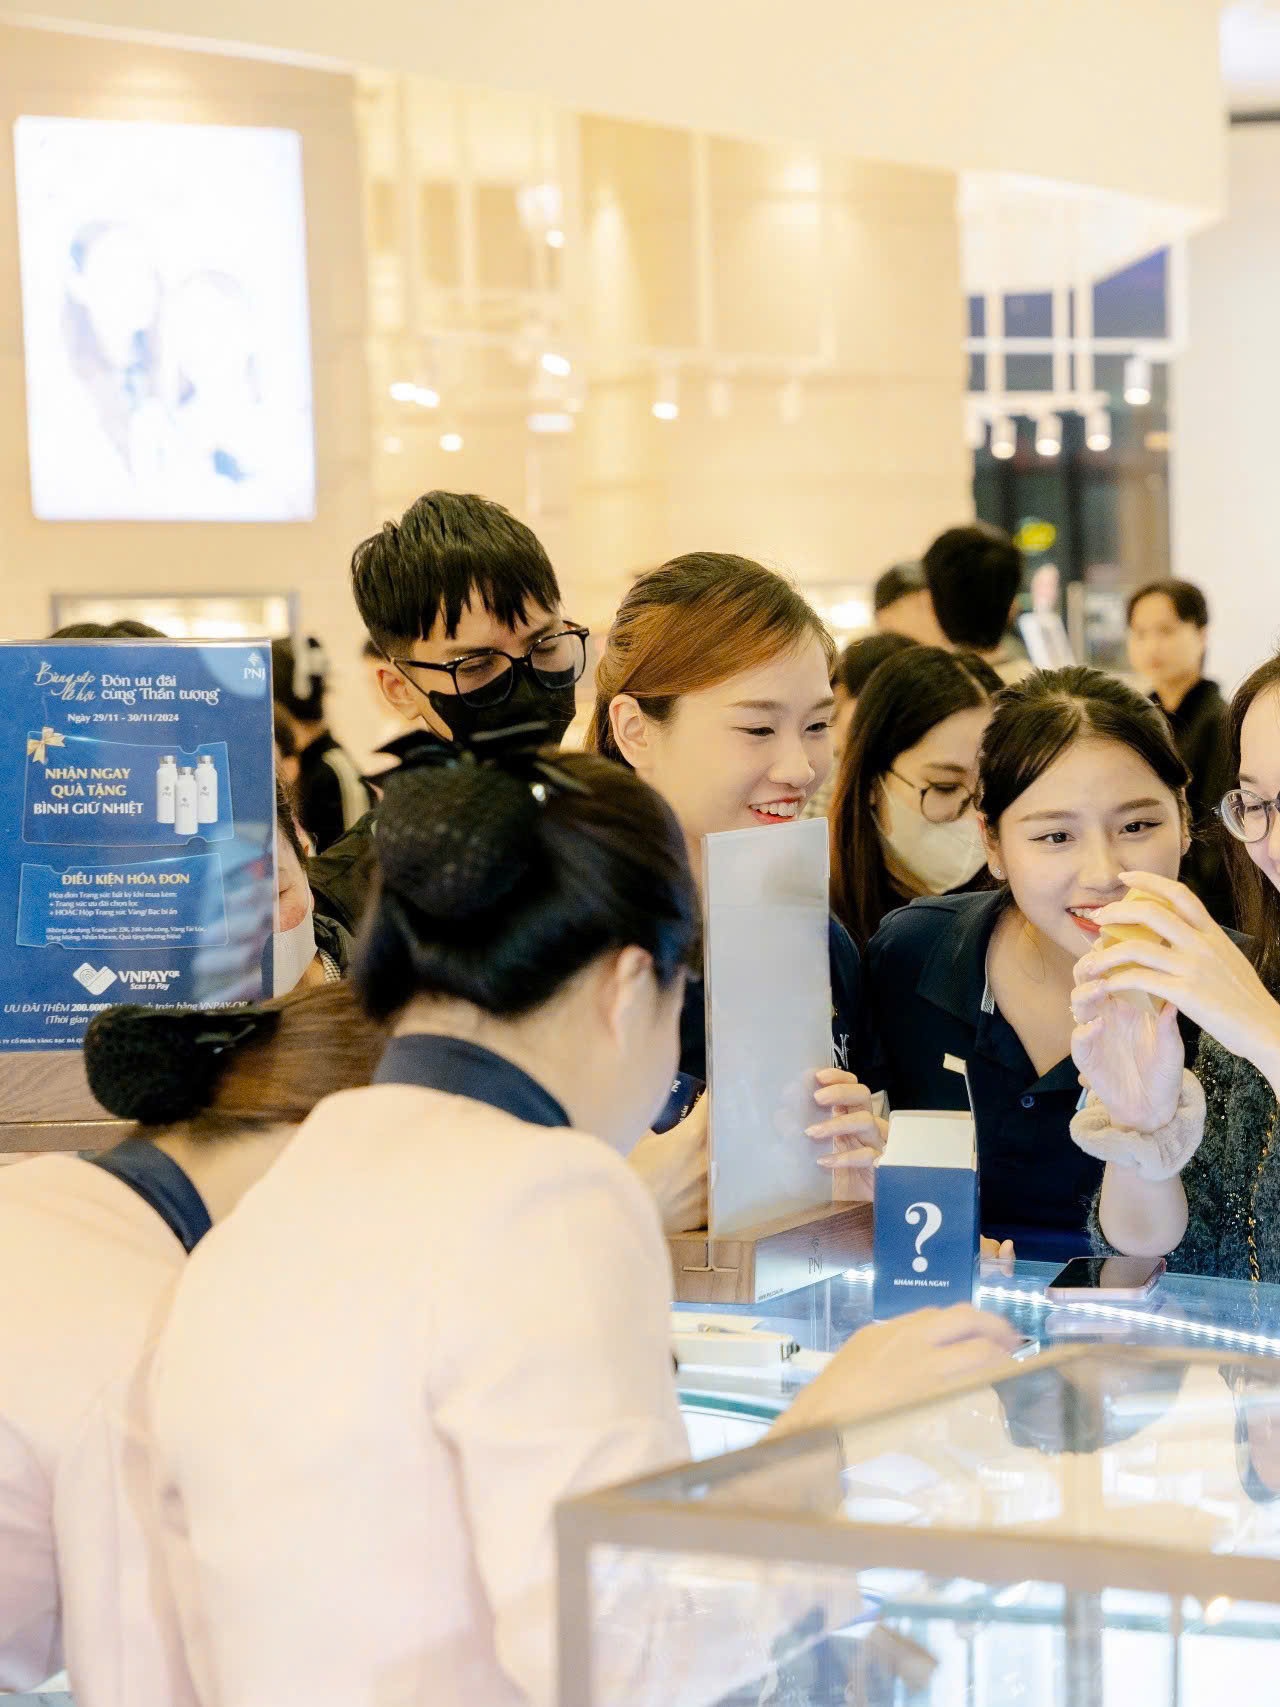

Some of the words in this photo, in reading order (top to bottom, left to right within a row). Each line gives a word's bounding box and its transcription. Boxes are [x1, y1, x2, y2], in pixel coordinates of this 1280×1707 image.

[100, 674, 130, 687] Đón
[156, 674, 176, 687] đãi
[244, 668, 266, 680] PNJ
[101, 688, 137, 705] cùng
[68, 713, 90, 724] Ngày
[93, 714, 118, 722] 29/11
[128, 714, 179, 722] 30/11/2024
[45, 766, 88, 782] NHẬN
[91, 768, 131, 780] NGAY
[51, 782, 84, 799] QUÀ
[86, 783, 127, 798] TẶNG
[33, 800, 69, 814] BÌNH
[72, 801, 100, 814] GIỮ
[102, 801, 144, 816] NHIỆT
[62, 872, 92, 884] ĐIỀU
[96, 873, 124, 886] KIỆN
[127, 872, 156, 884] HÓA
[159, 873, 190, 884] ĐƠN
[42, 1002, 70, 1012] THÊM
[46, 1014, 68, 1024] (Thời
[70, 1016, 88, 1026] gian
[808, 1254, 822, 1274] PNJ
